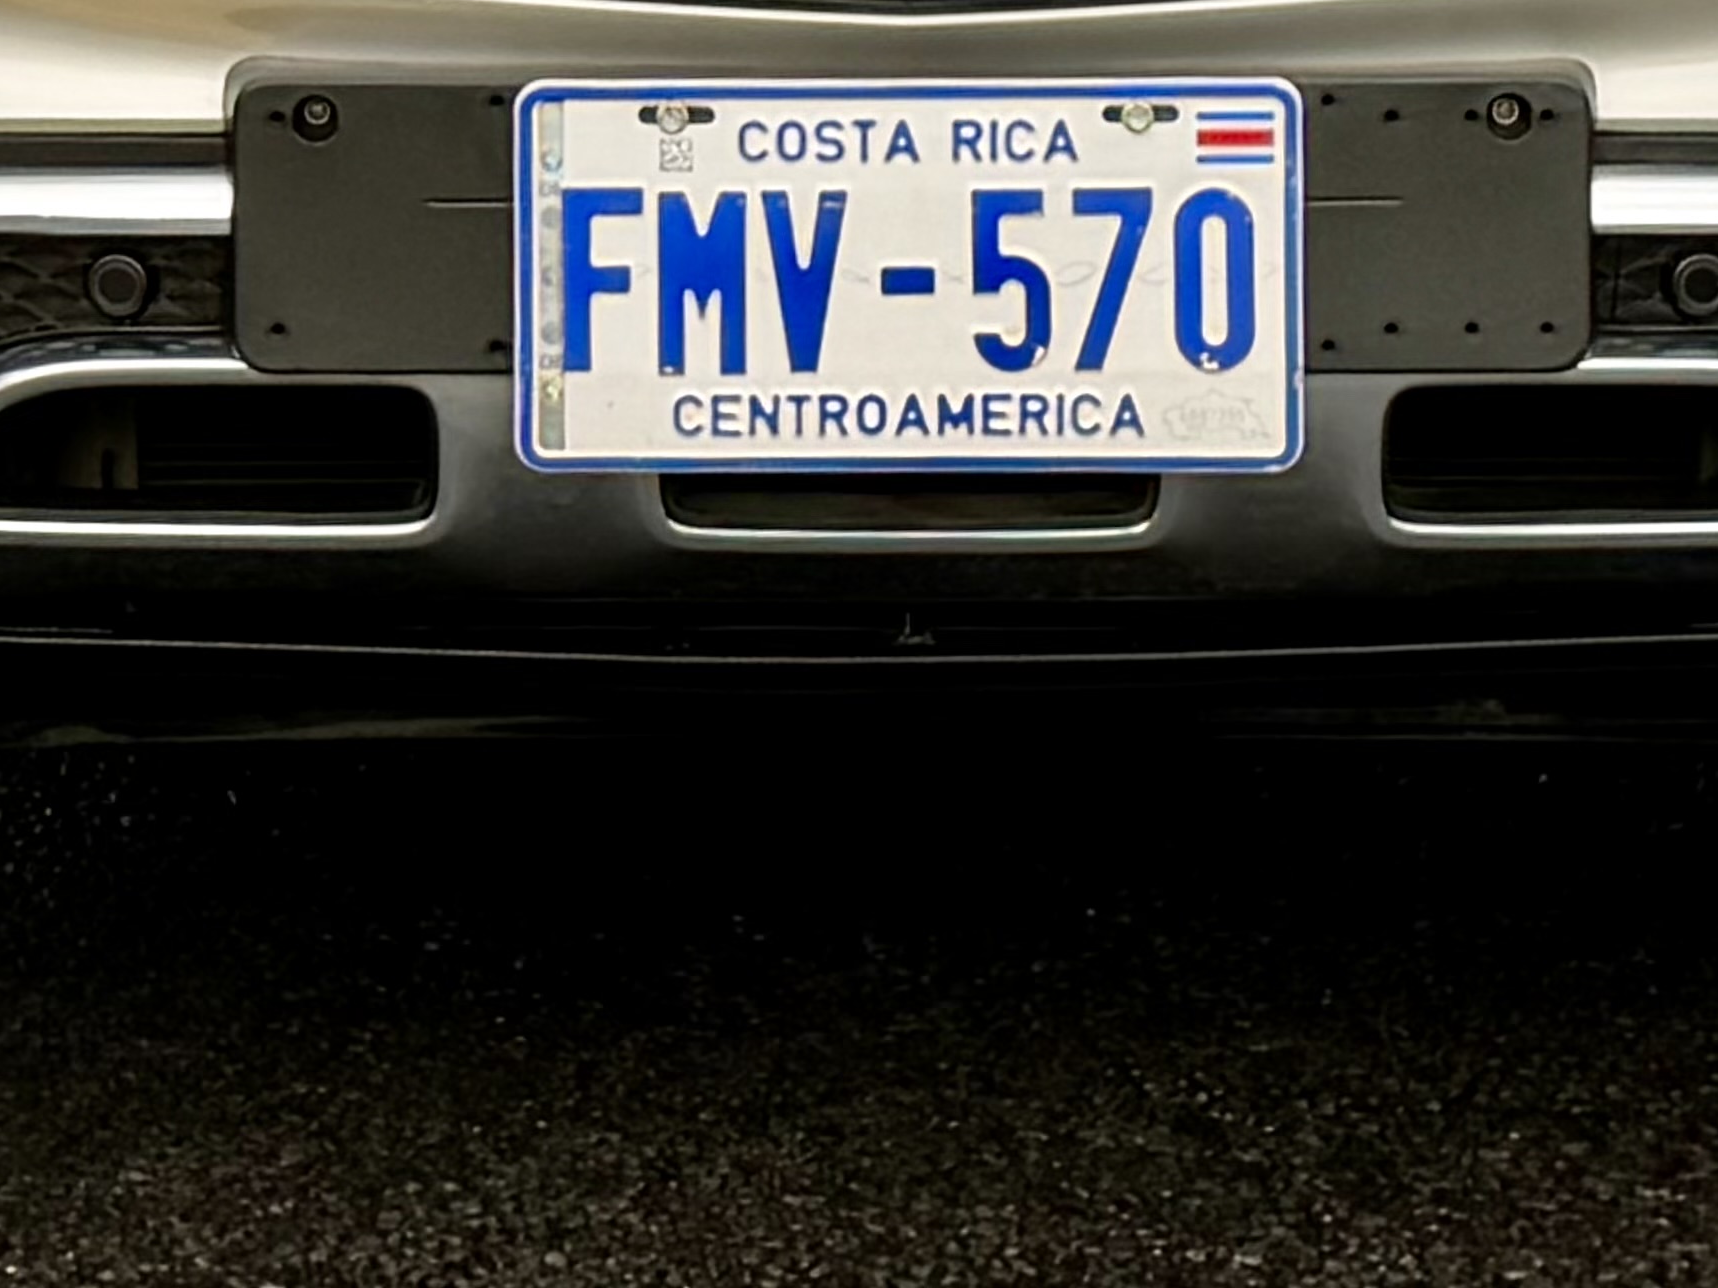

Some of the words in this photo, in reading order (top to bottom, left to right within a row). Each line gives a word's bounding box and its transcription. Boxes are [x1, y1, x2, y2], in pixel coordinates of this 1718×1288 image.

[737, 118, 922, 164] COSTA
[950, 118, 1081, 164] RICA
[561, 186, 1256, 377] FMV-570
[672, 392, 1147, 440] CENTROAMERICA
